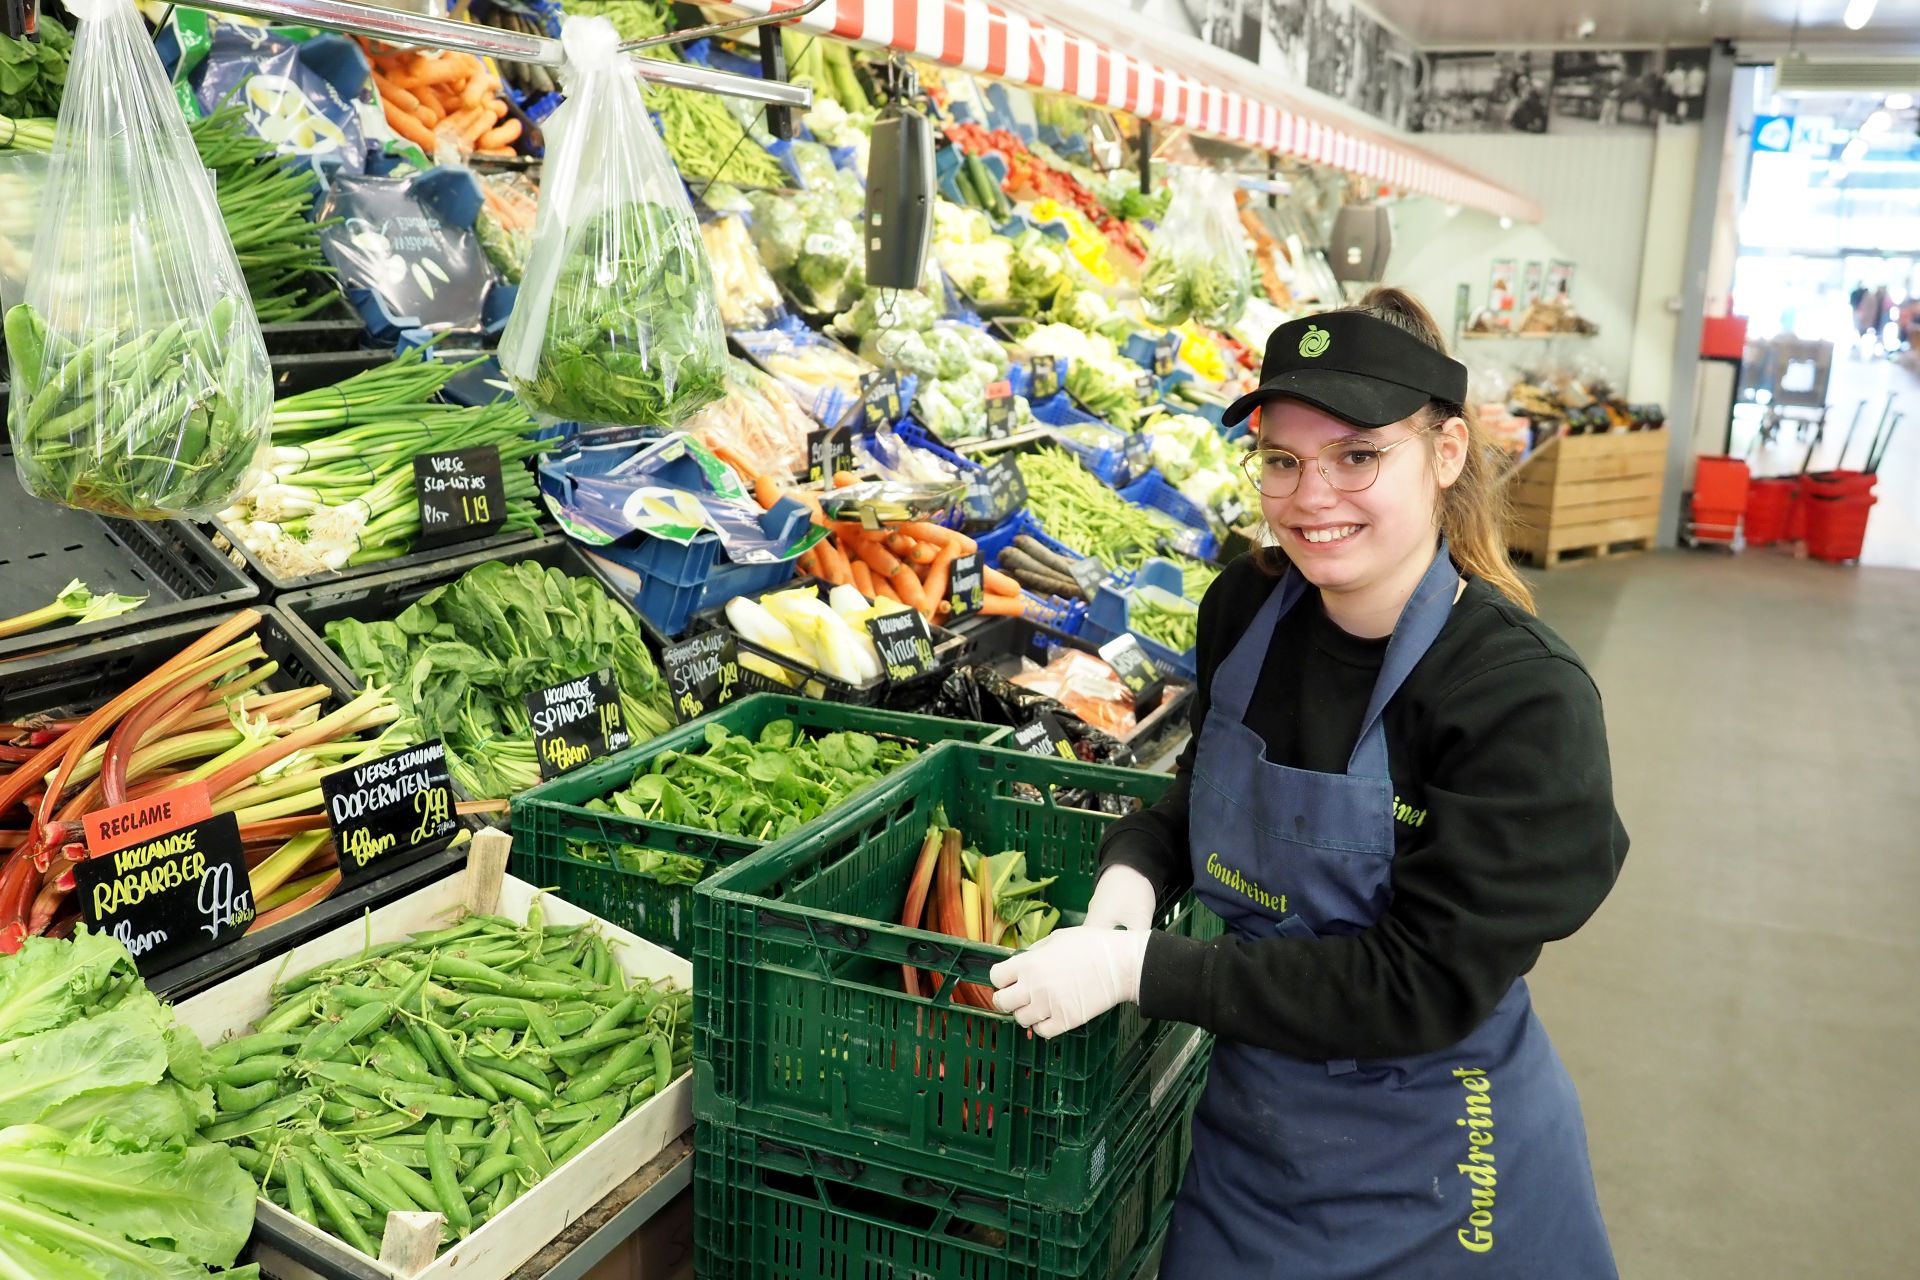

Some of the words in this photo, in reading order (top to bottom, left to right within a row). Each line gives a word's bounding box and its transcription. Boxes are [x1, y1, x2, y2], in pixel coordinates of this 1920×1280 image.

[462, 495, 490, 525] 1.19
[353, 757, 397, 788] VERSE
[99, 801, 172, 841] RECLAME
[92, 851, 207, 921] RABARBER
[1206, 852, 1288, 913] Goudreinet
[1452, 1067, 1498, 1253] Goudreinet
